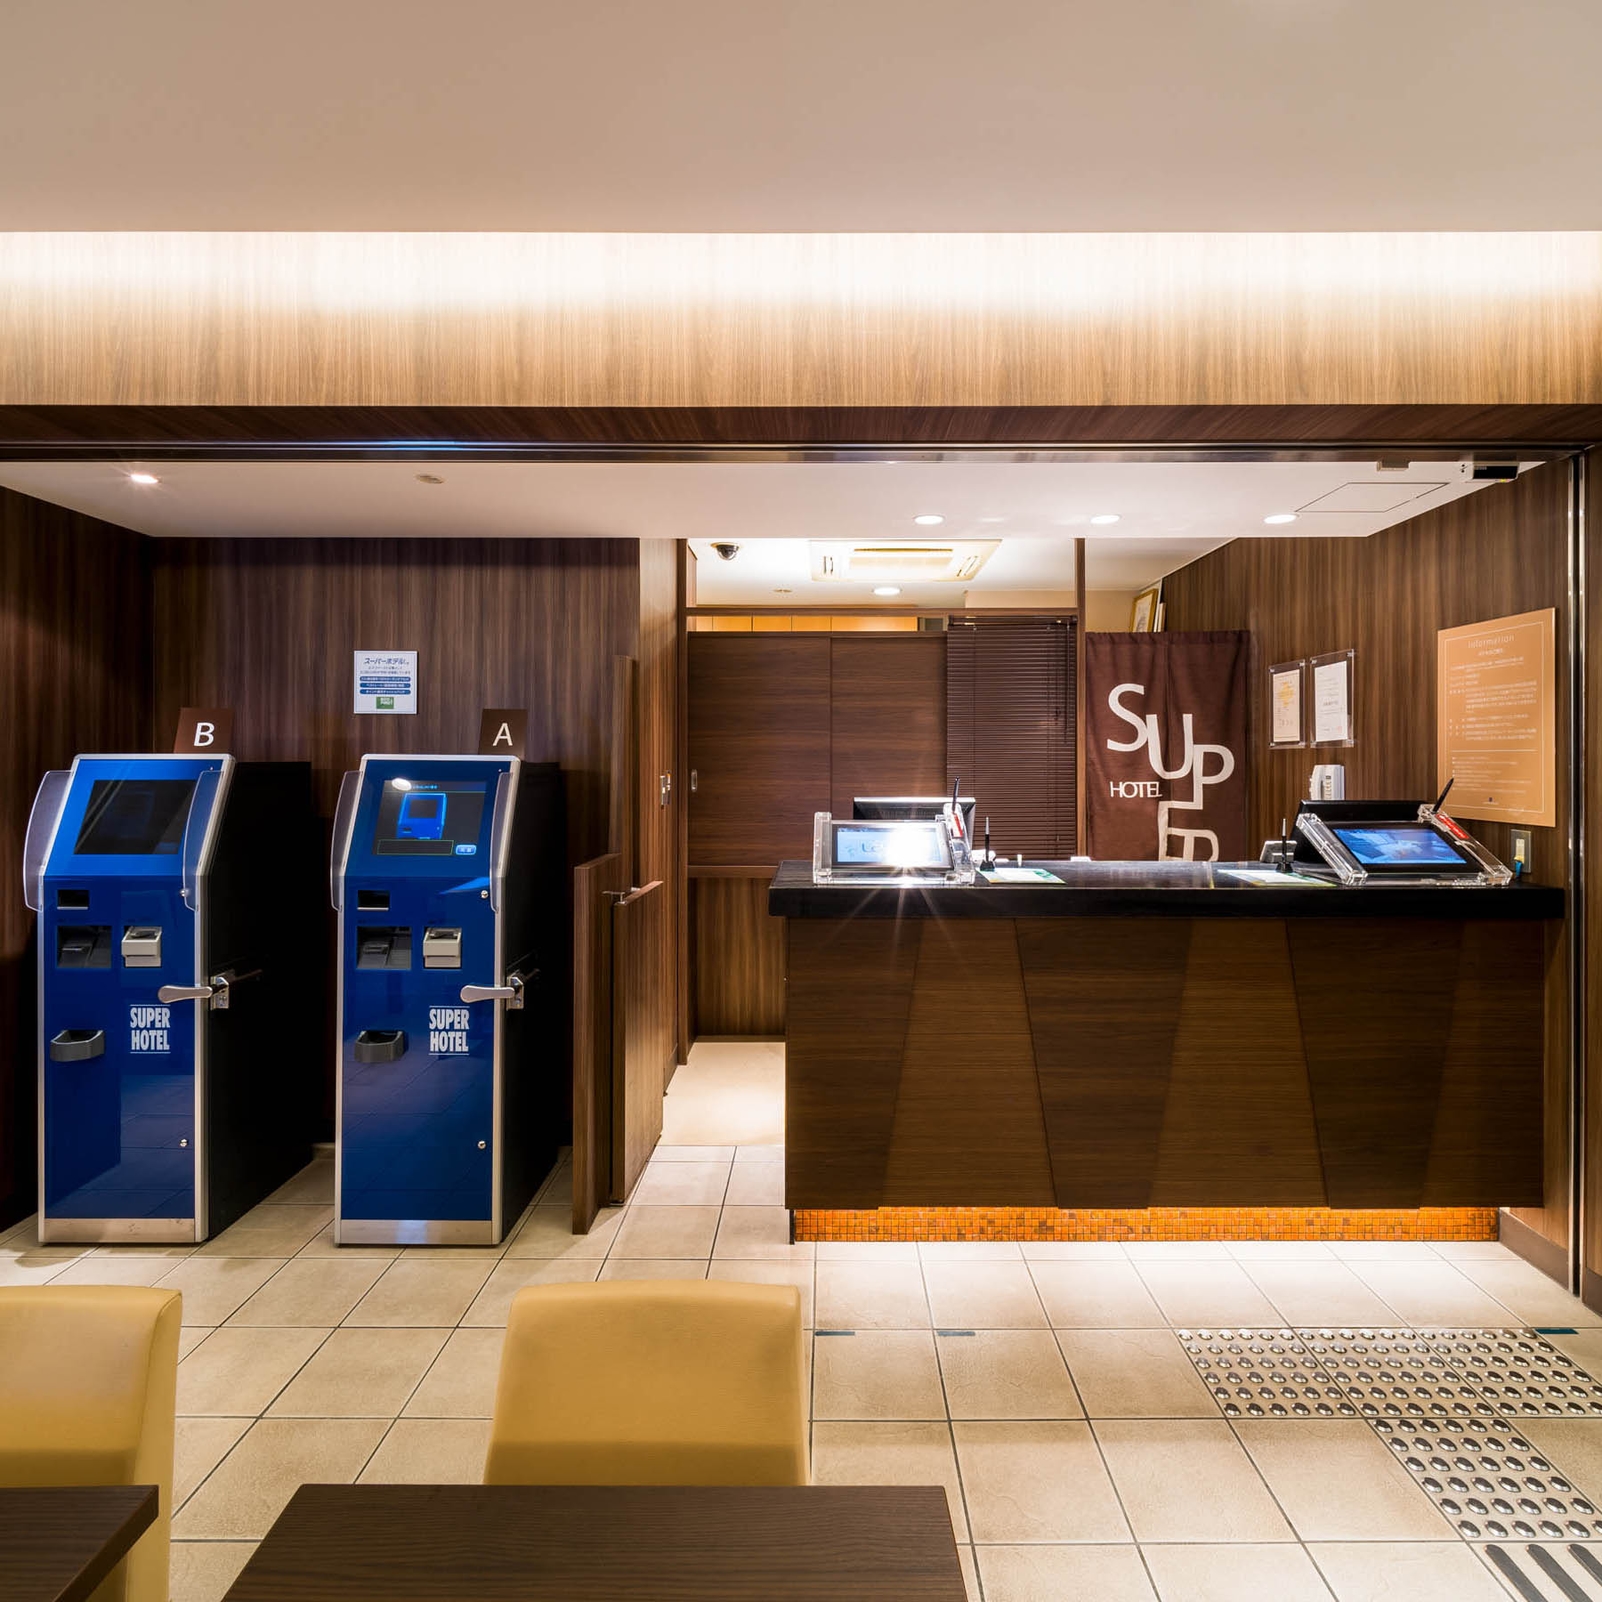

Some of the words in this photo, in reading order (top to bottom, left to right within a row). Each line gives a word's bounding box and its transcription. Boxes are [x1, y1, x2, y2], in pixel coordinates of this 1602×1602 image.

[193, 722, 215, 747] B
[492, 722, 513, 747] A
[1109, 781, 1163, 798] HOTEL
[130, 1007, 171, 1028] SUPER
[429, 1008, 470, 1030] SUPER
[131, 1029, 170, 1051] HOTEL
[430, 1031, 469, 1052] HOTEL
